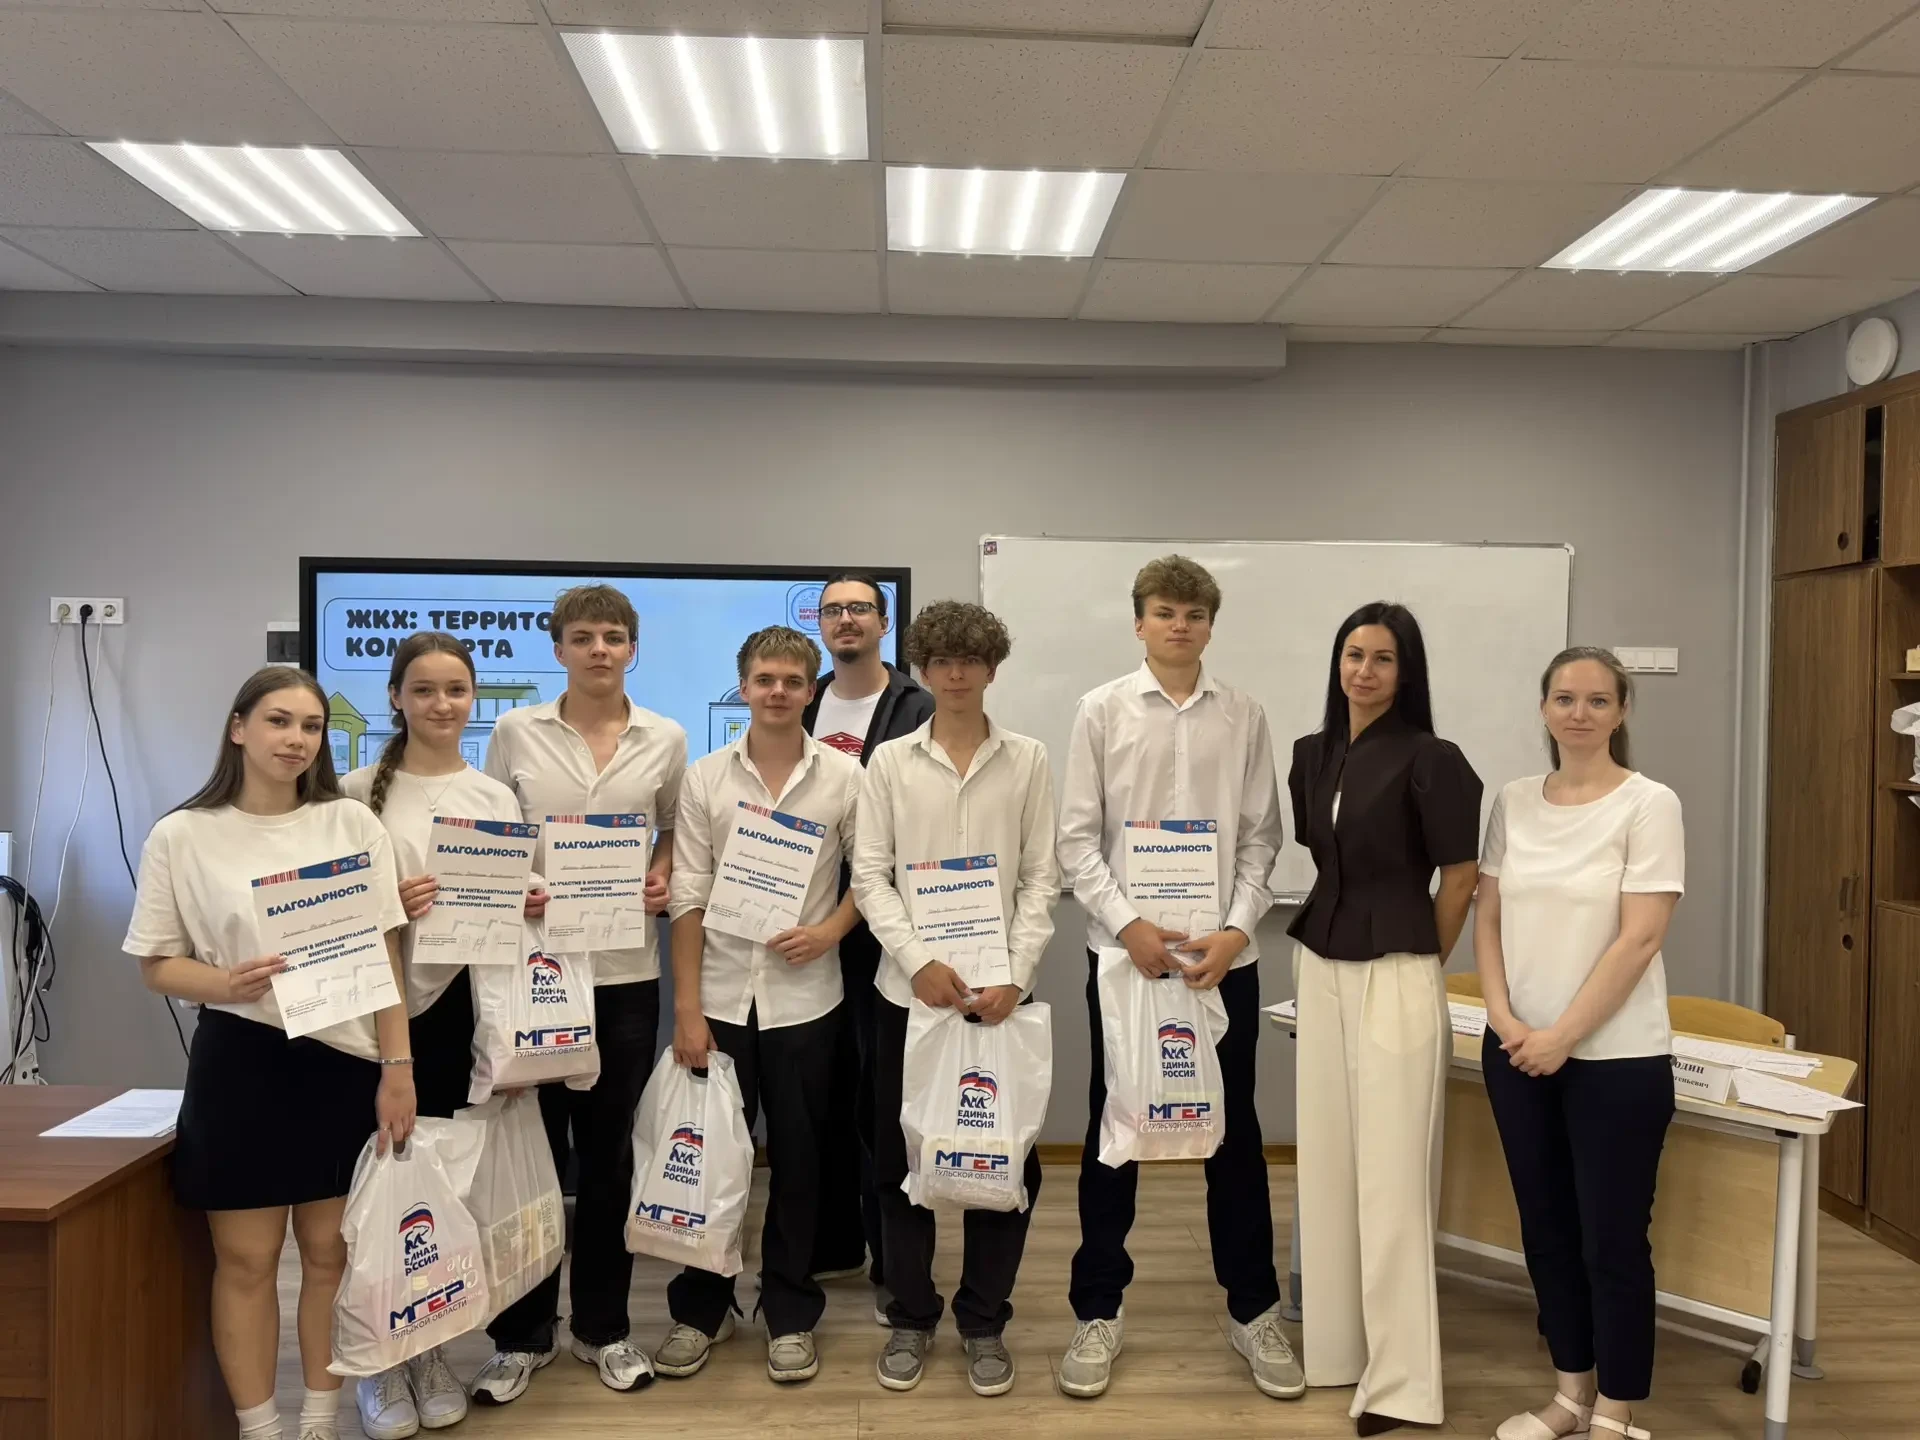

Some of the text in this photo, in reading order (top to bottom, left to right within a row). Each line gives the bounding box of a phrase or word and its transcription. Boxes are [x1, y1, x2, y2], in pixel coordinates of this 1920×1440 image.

[346, 608, 554, 631] ЖКХ: ТЕРРИТО
[554, 840, 640, 850] БЛАГОДАРНОСТЬ
[737, 826, 814, 855] БЛАГОДАРНОСТЬ
[437, 844, 529, 858] БЛАГОДАРНОСТЬ
[1133, 844, 1213, 853] БЛАГОДАРНОСТЬ
[587, 877, 642, 885] ИНТЕЛЛЕКТУАЛЬНОЙ
[730, 864, 752, 874] УЧАСТИЕ
[756, 872, 806, 888] ИНТЕЛЛЕКТУАЛЬНОЙ
[748, 876, 776, 887] ВИКТОРИНЕ
[738, 879, 768, 892] ТЕРРИТОРИЯ
[916, 879, 995, 895] БЛАГОДАРНОСТЬ
[267, 883, 368, 917] БЛАГОДАРНОСТЬ
[951, 916, 1000, 926] ИНТЕЛЛЕКТУАЛЬНОЙ
[315, 924, 378, 949] ИНТЕЛЛЕКТУАЛЬНОЙ
[946, 926, 974, 934] ВИКТОРИНЕ
[308, 943, 345, 958] ВИКТОРИНЕ
[298, 953, 339, 969] ТЕРРИТОРИЯ
[515, 1026, 591, 1048] МГЕР
[516, 1048, 556, 1058] ТУЛЬСКОЙ
[1162, 1070, 1196, 1078] РОССИЯ
[1674, 1061, 1704, 1074] ОДИН
[1674, 1076, 1709, 1088] геньевич
[958, 1110, 995, 1119] ЕДИНАЯ
[1149, 1102, 1210, 1119] МГЕР
[957, 1118, 994, 1128] РОССИЯ
[935, 1150, 1008, 1170] МГЕР
[664, 1163, 700, 1177] ЕДИНАЯ
[934, 1170, 974, 1179] ТУЛЬСКОЙ
[662, 1172, 698, 1186] РОССИЯ
[636, 1200, 706, 1228] МГЕР
[636, 1218, 706, 1240] ТУЛЬСКОЙ ОБЛАСТИ
[405, 1252, 440, 1276] РССИЯ
[390, 1280, 464, 1330] МГЕР
[432, 1299, 468, 1322] ОБЛАСТИ
